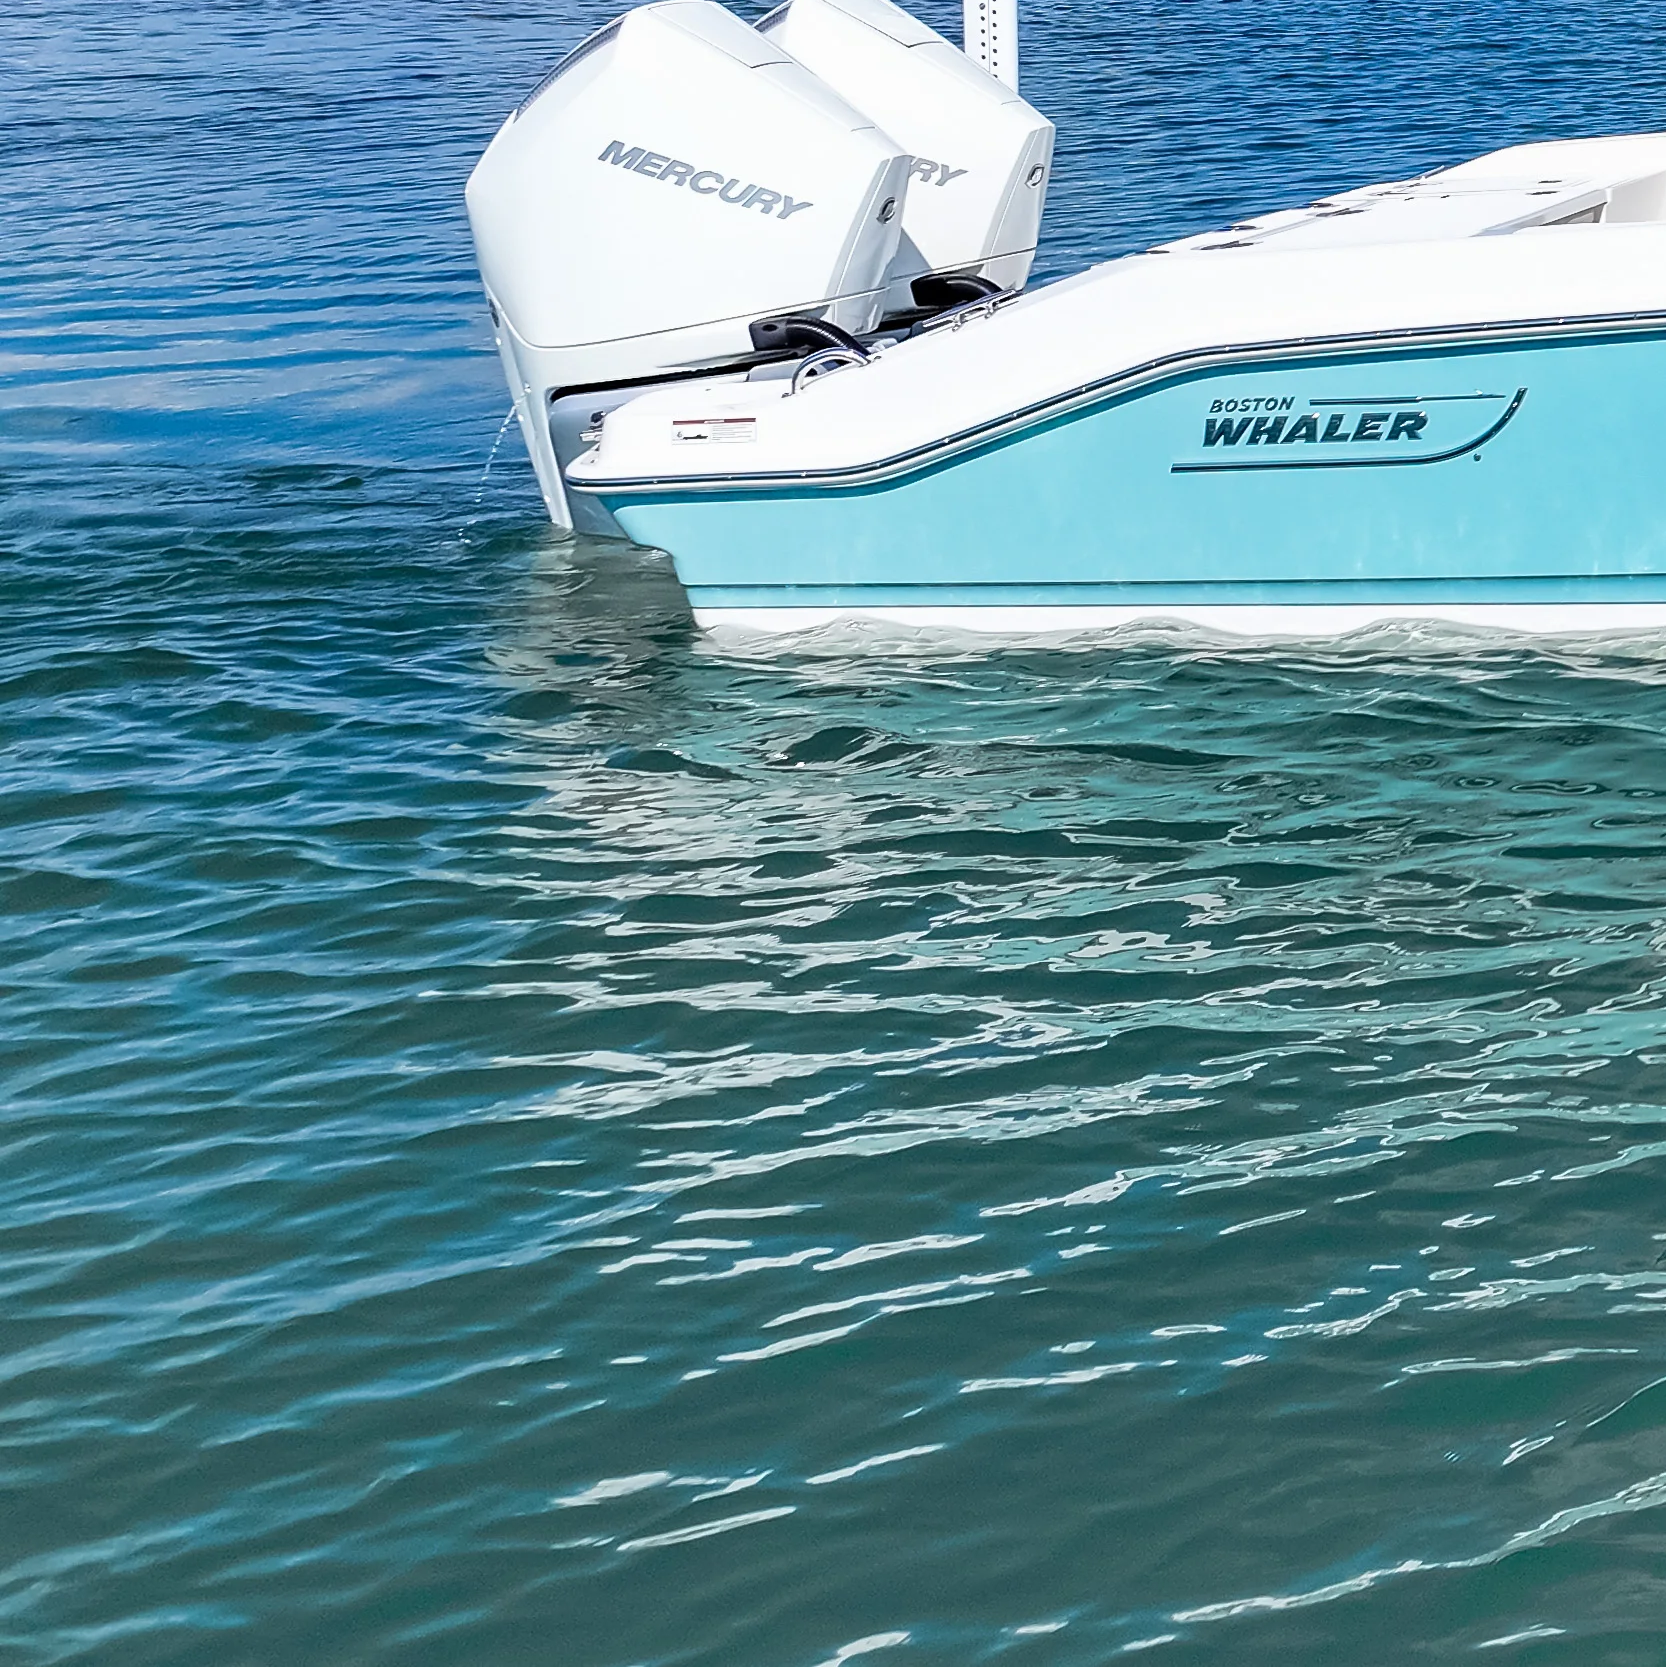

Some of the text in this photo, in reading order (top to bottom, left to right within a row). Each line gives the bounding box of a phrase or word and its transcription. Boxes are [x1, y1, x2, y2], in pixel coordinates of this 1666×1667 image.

[597, 140, 814, 219] MERCURY
[1209, 396, 1295, 413] BOSTON
[1202, 411, 1428, 447] WHALER
